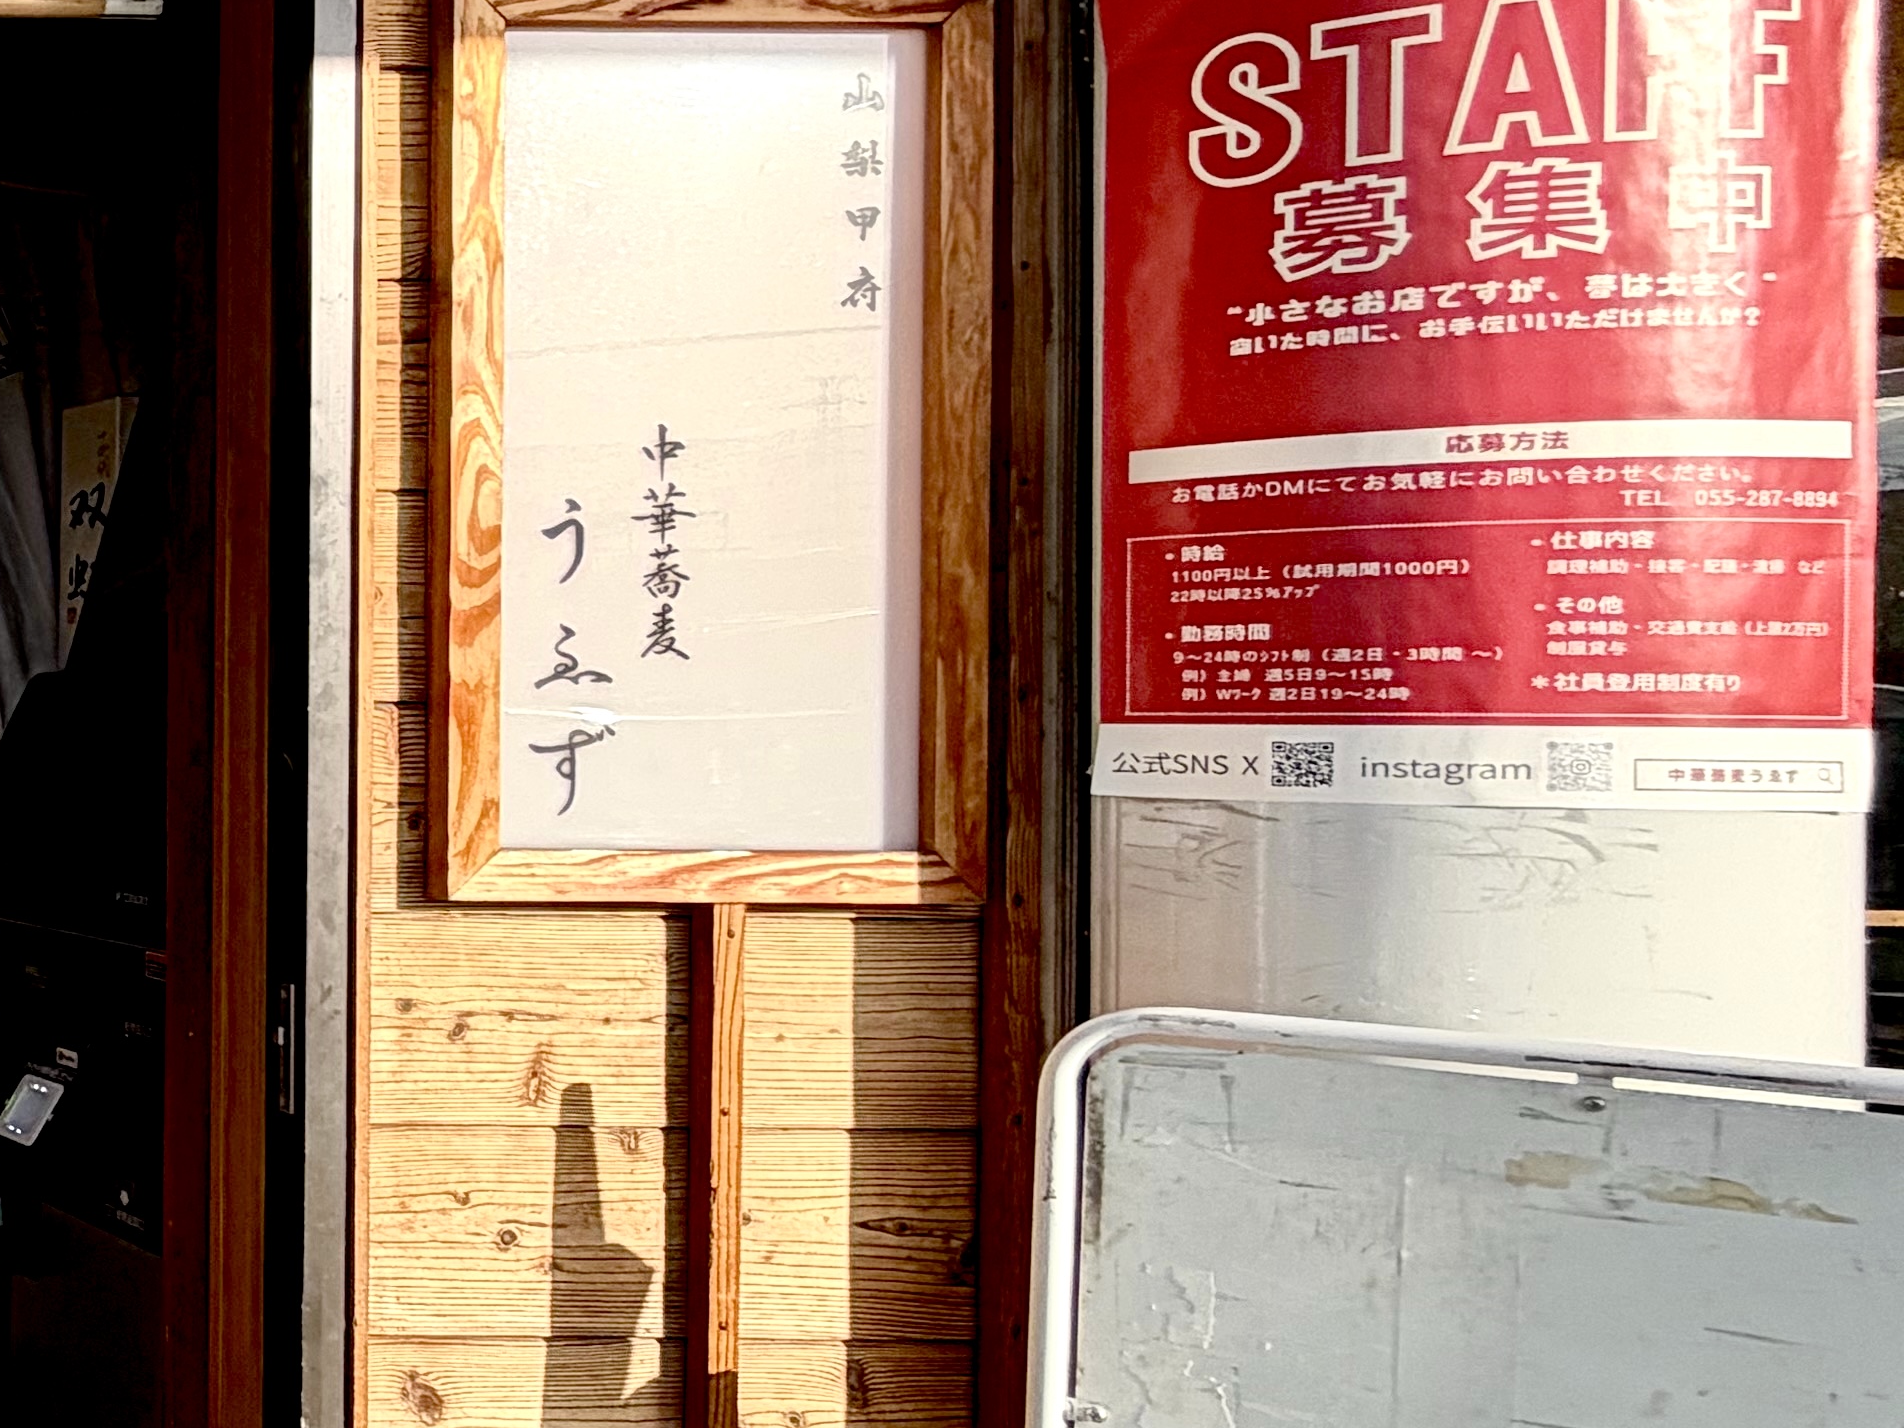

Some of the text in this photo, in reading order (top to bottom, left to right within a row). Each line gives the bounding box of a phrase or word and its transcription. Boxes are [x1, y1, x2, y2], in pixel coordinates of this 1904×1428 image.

[840, 72, 886, 314] 山梨甲府
[1270, 151, 1773, 282] 募集中
[1445, 430, 1570, 455] 応募方法
[1619, 489, 1670, 507] TEL
[630, 423, 697, 662] 中華蕎麦
[1181, 543, 1226, 562] 時給
[1550, 530, 1655, 550] 仕事内容
[1556, 595, 1624, 615] その他
[1181, 623, 1271, 642] 勤務時間
[528, 497, 617, 818] うゑず
[1112, 751, 1230, 776] 公式SNS
[1242, 755, 1260, 776] X
[1360, 756, 1532, 785] instagram
